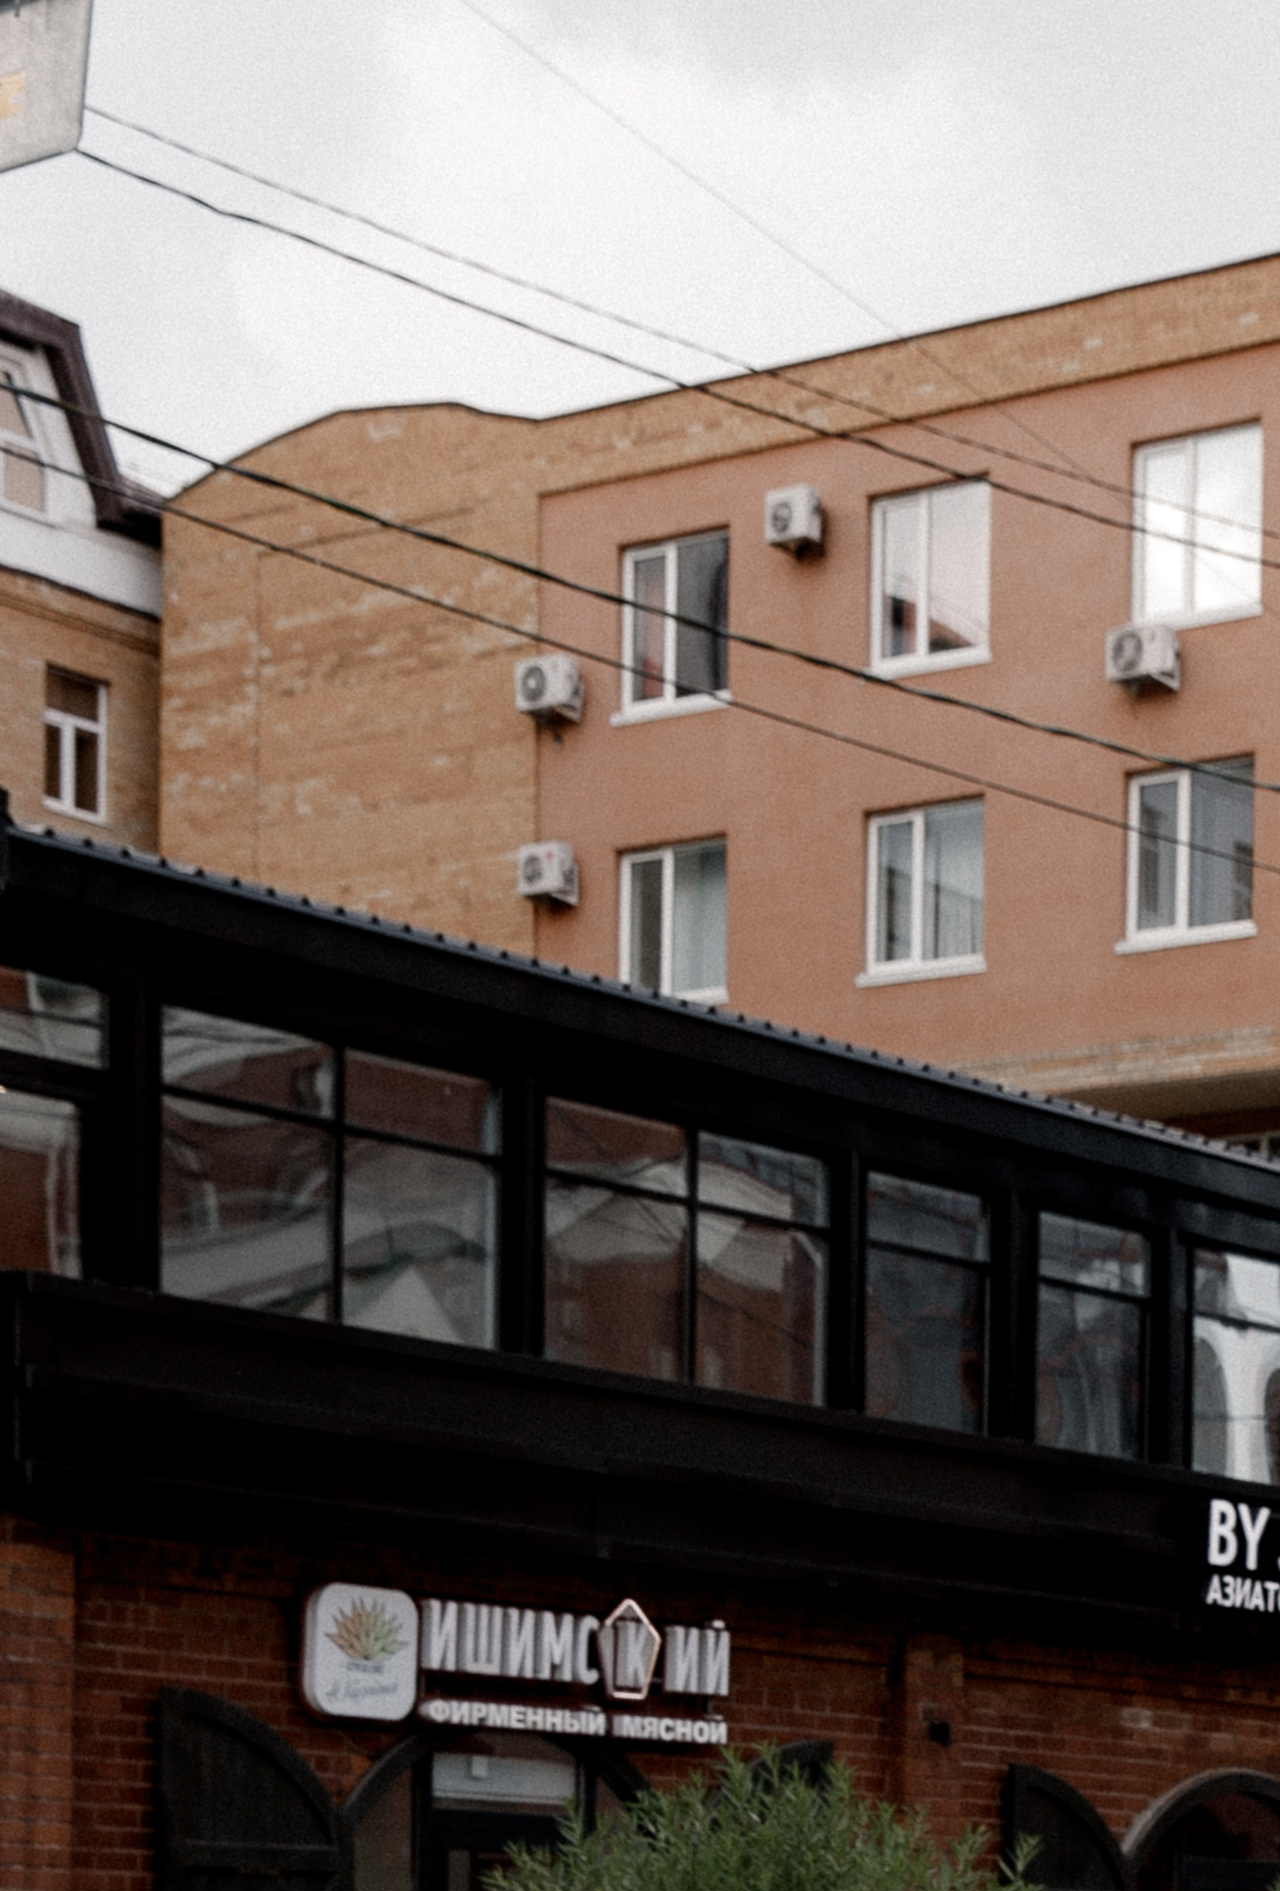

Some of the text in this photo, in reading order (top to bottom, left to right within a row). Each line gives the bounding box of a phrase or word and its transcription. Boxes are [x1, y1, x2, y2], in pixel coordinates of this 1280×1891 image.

[1206, 1498, 1271, 1571] BY
[420, 1598, 731, 1697] ИШИМСКИЙ
[420, 1699, 728, 1745] ФИРМЕННЫЙ МЯСНОЙ
